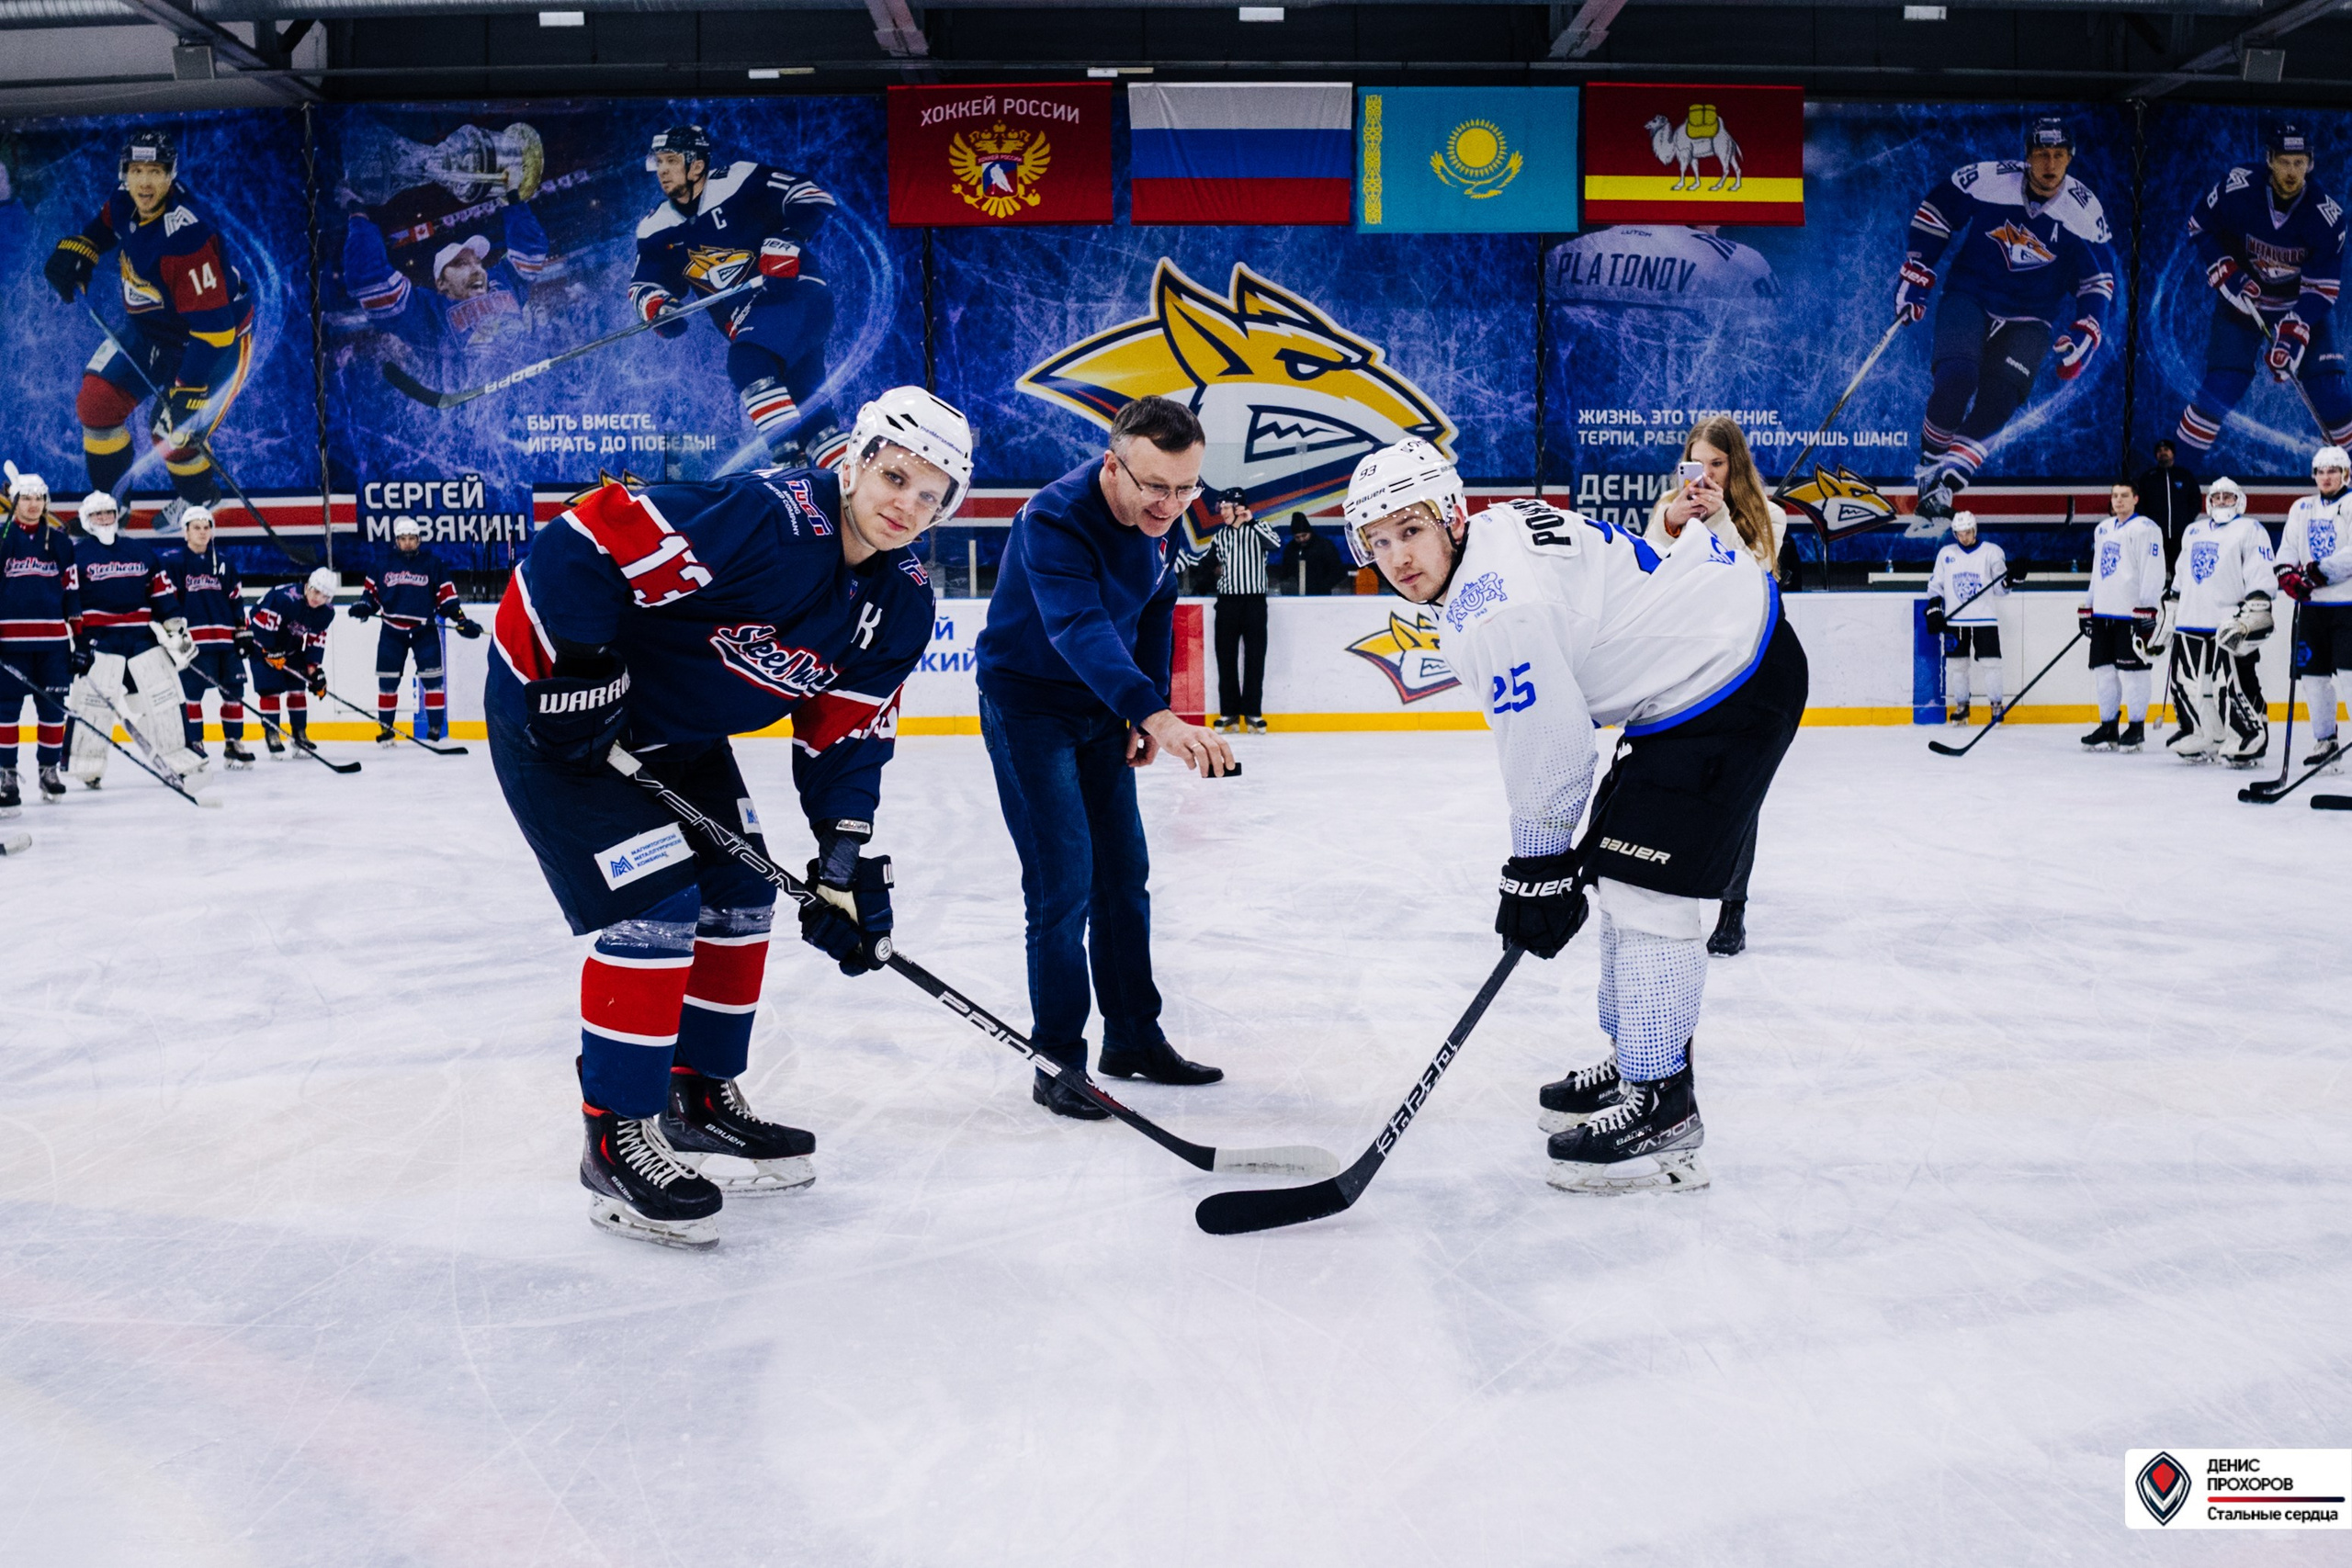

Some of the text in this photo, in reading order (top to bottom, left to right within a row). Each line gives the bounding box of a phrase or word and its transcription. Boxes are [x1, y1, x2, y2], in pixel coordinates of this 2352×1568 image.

[921, 96, 1080, 127] ХОККЕЙ РОССИИ
[711, 208, 728, 230] C
[2050, 222, 2058, 243] A
[188, 262, 217, 296] 14
[1556, 252, 1697, 294] PLATONOV
[527, 413, 657, 431] БЫТЬ ВМЕСТЕ,
[1578, 410, 1647, 426] ЖИЗНЬ,
[1651, 410, 1684, 425] ЭТО
[527, 435, 716, 455] ИГРАТЬ ДО ПОБЕДЫ!
[1578, 430, 1908, 447] ТЕРПИ, РАБО ПОЛУЧИШЬ ШАНС!
[1359, 465, 1377, 481] 93
[364, 474, 485, 510] СЕРГЕЙ
[783, 490, 801, 514] MINING
[1356, 487, 1386, 506] BAUER
[1577, 474, 1670, 506] ДЕНИ
[763, 481, 800, 536] UNITED COMPANY
[368, 514, 527, 544] МЗЯКИН
[620, 536, 714, 608] 13
[851, 602, 883, 649] K
[1493, 661, 1536, 714] 25
[1600, 837, 1672, 865] BAUER
[1498, 874, 1574, 898] BAUER
[937, 990, 1063, 1078] PRIDE
[705, 1122, 747, 1148] BAUER
[1615, 1123, 1653, 1146] BAUER
[1628, 1112, 1701, 1155] VAPOR
[610, 1175, 635, 1202] BAUER
